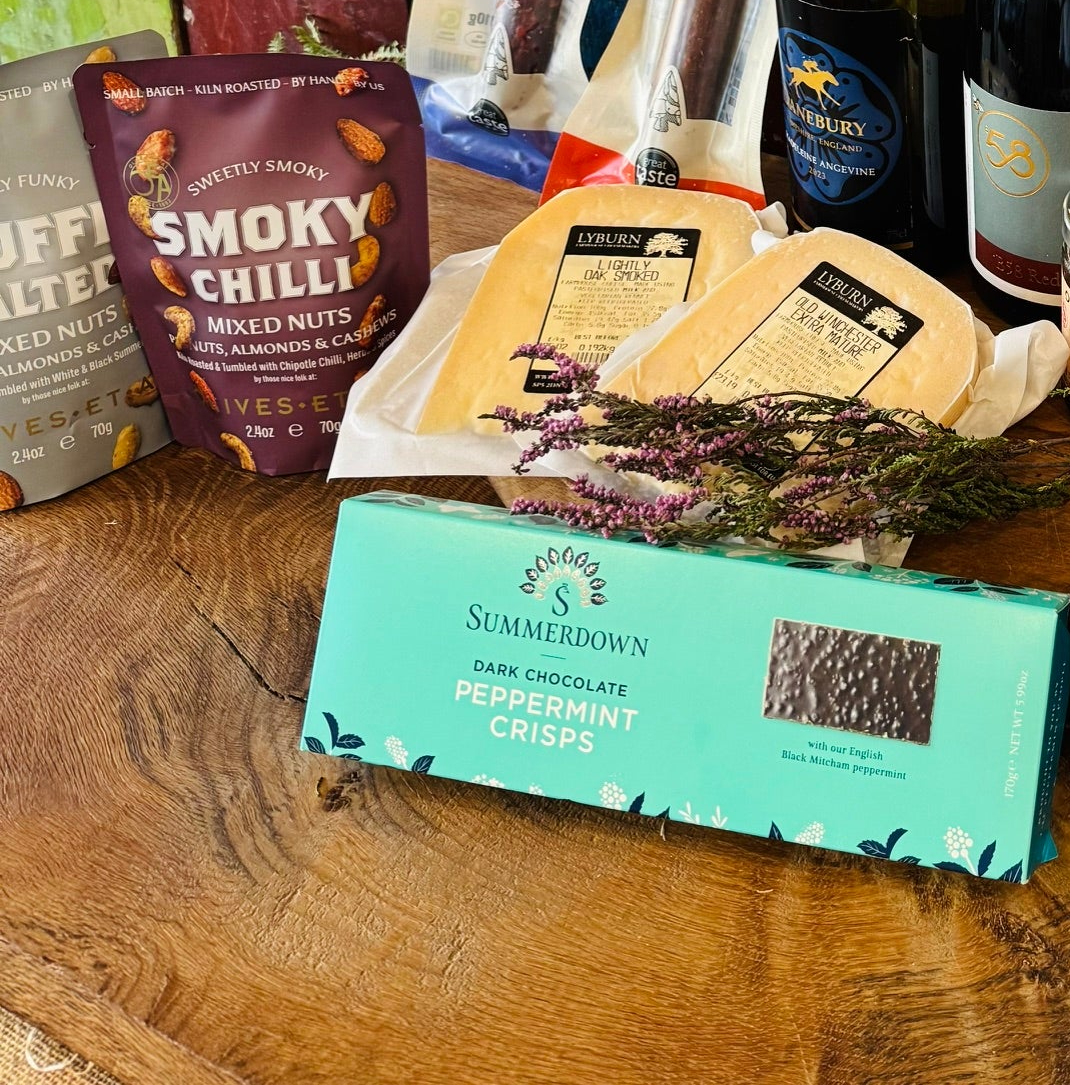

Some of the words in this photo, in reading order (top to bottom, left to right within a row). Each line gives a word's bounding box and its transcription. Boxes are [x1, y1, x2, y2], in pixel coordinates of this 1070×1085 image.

[103, 85, 144, 100] SMALL
[145, 84, 185, 98] BATCH
[194, 82, 223, 96] KILN
[225, 77, 281, 95] ROASTED
[291, 76, 306, 88] BY
[818, 137, 863, 153] ENGLAND
[985, 129, 1037, 179] 58
[18, 173, 80, 192] FUNKY
[187, 161, 261, 197] SWEETLY
[265, 159, 331, 183] SMOKY
[150, 191, 375, 259] SMOKY
[577, 232, 643, 245] LYBURN
[189, 255, 355, 305] CHILLI
[583, 270, 609, 282] OAK
[613, 270, 660, 282] SMOKED
[597, 260, 652, 272] LIGHTLY
[818, 270, 874, 309] LYBURN
[57, 304, 118, 342] NUTS
[207, 314, 282, 337] MIXED
[288, 307, 353, 332] NUTS
[790, 308, 825, 336] EXTRA
[825, 327, 865, 363] MATURE
[221, 360, 257, 373] Tumbled
[258, 359, 279, 372] with
[279, 356, 317, 373] Chipotle
[318, 353, 346, 368] Chilli,
[466, 603, 650, 658] SUMMERDOWN
[473, 659, 519, 679] DARK
[525, 668, 629, 697] CHOCOLATE
[455, 679, 639, 732] PEPPERMINT
[489, 715, 595, 754] CRISPS
[781, 749, 807, 763] Black
[809, 754, 850, 770] Mitcham
[852, 763, 907, 780] peppermint
